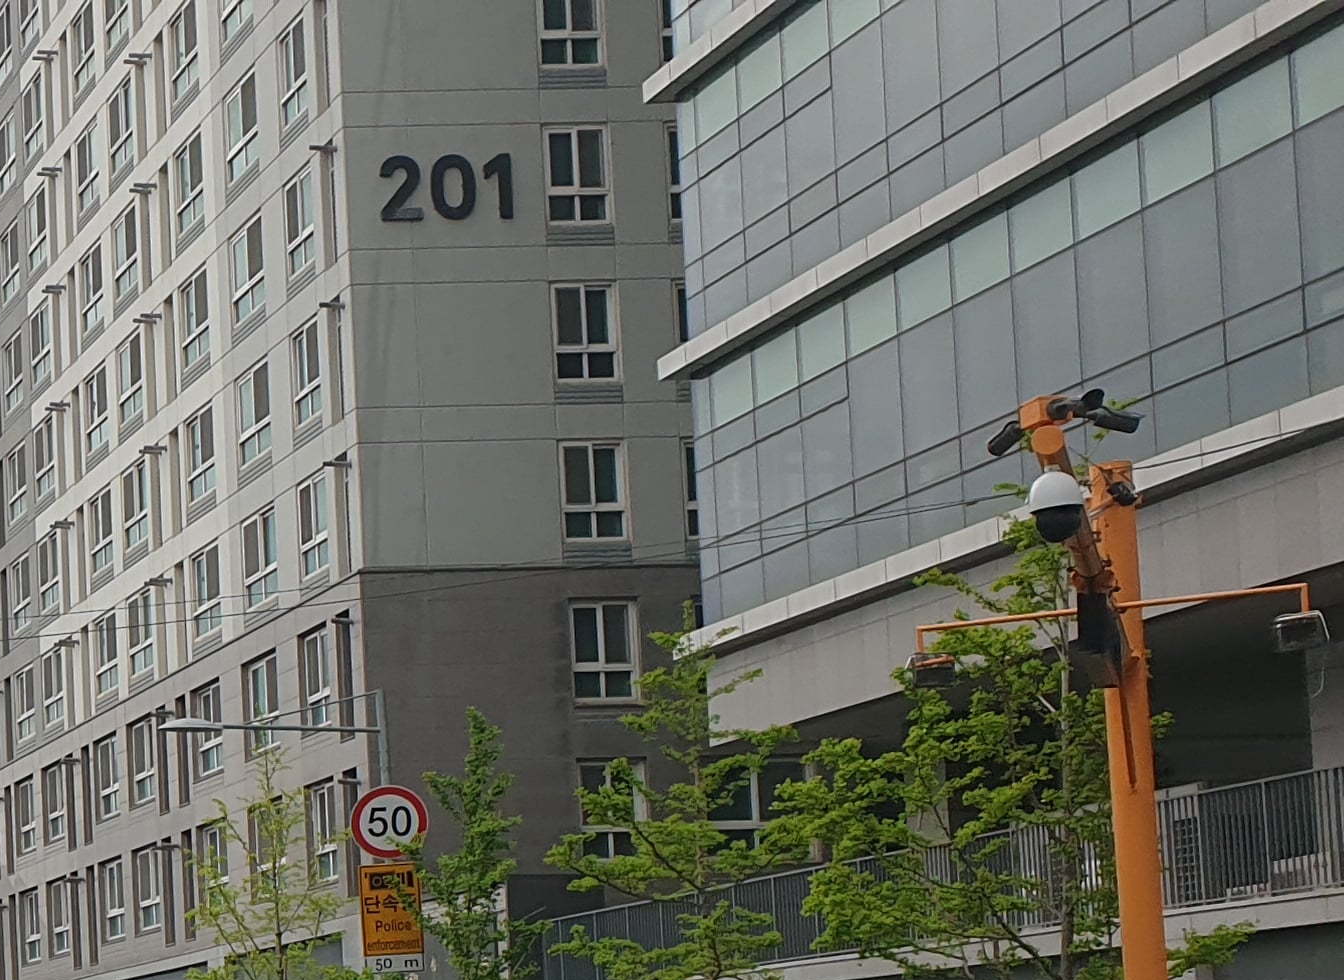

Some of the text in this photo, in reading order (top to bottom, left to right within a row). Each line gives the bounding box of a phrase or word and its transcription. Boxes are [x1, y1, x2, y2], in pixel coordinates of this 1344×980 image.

[379, 152, 514, 222] 201
[368, 805, 412, 837] 50
[375, 920, 412, 932] Police
[375, 958, 419, 972] 50 m
